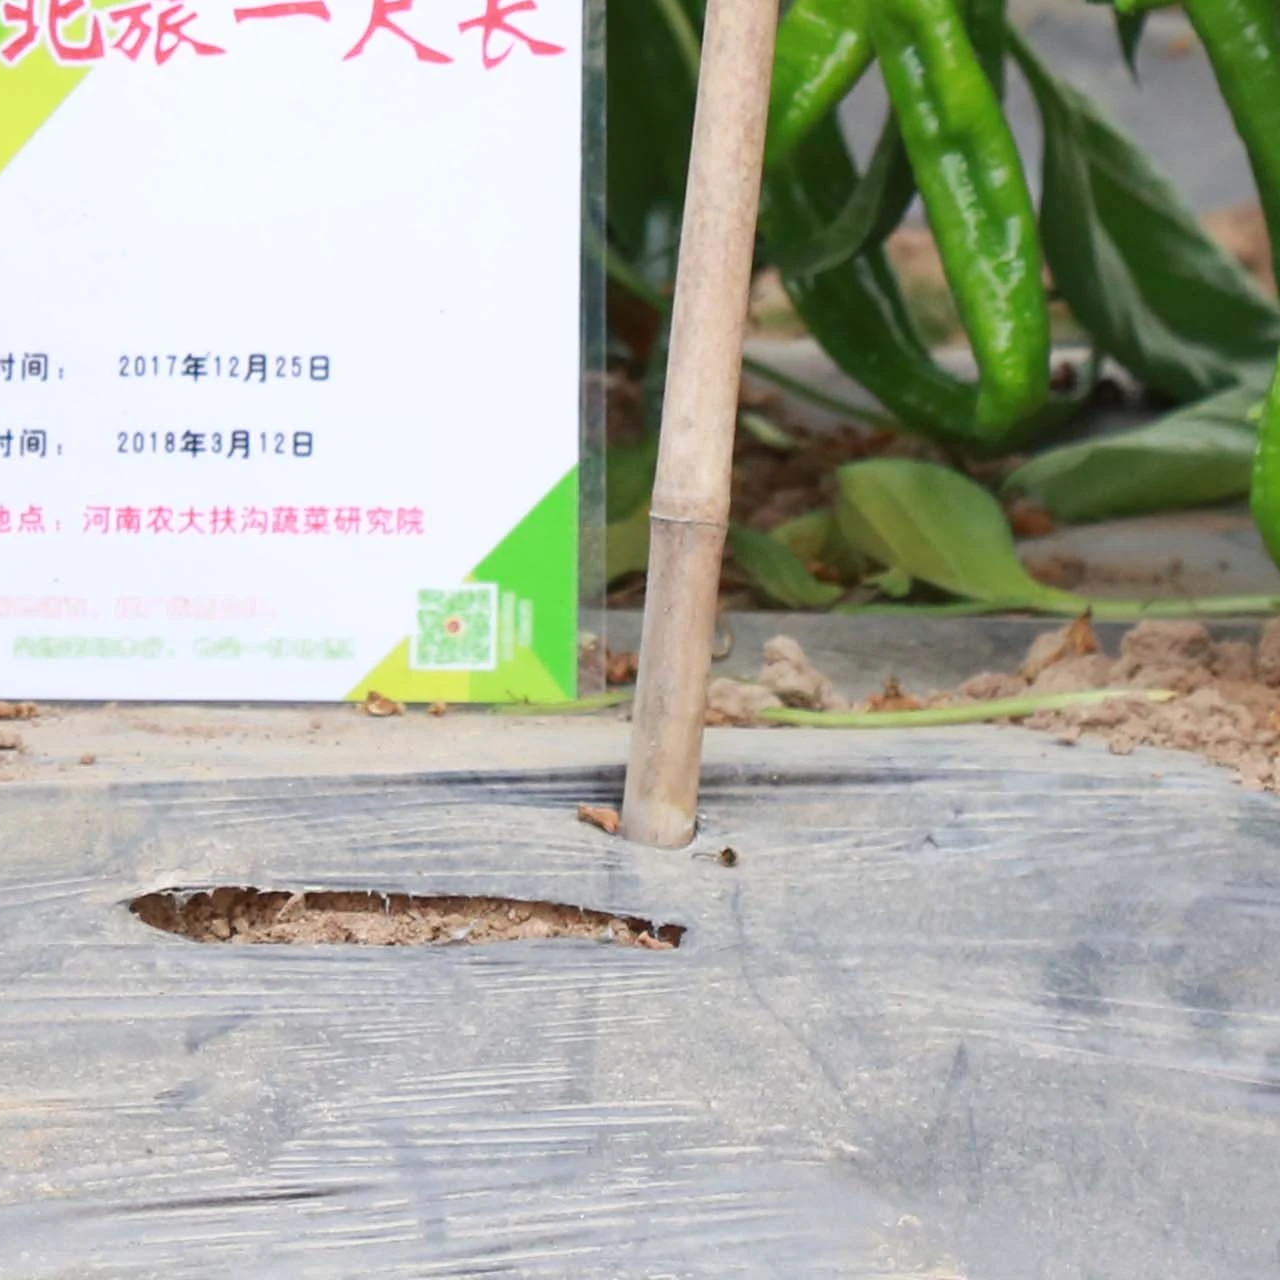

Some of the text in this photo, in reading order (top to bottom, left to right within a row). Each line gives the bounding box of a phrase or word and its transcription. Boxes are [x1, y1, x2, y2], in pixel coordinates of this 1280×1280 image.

[118, 352, 331, 383] 2017年12月25日
[116, 428, 315, 459] 2018年3月12日
